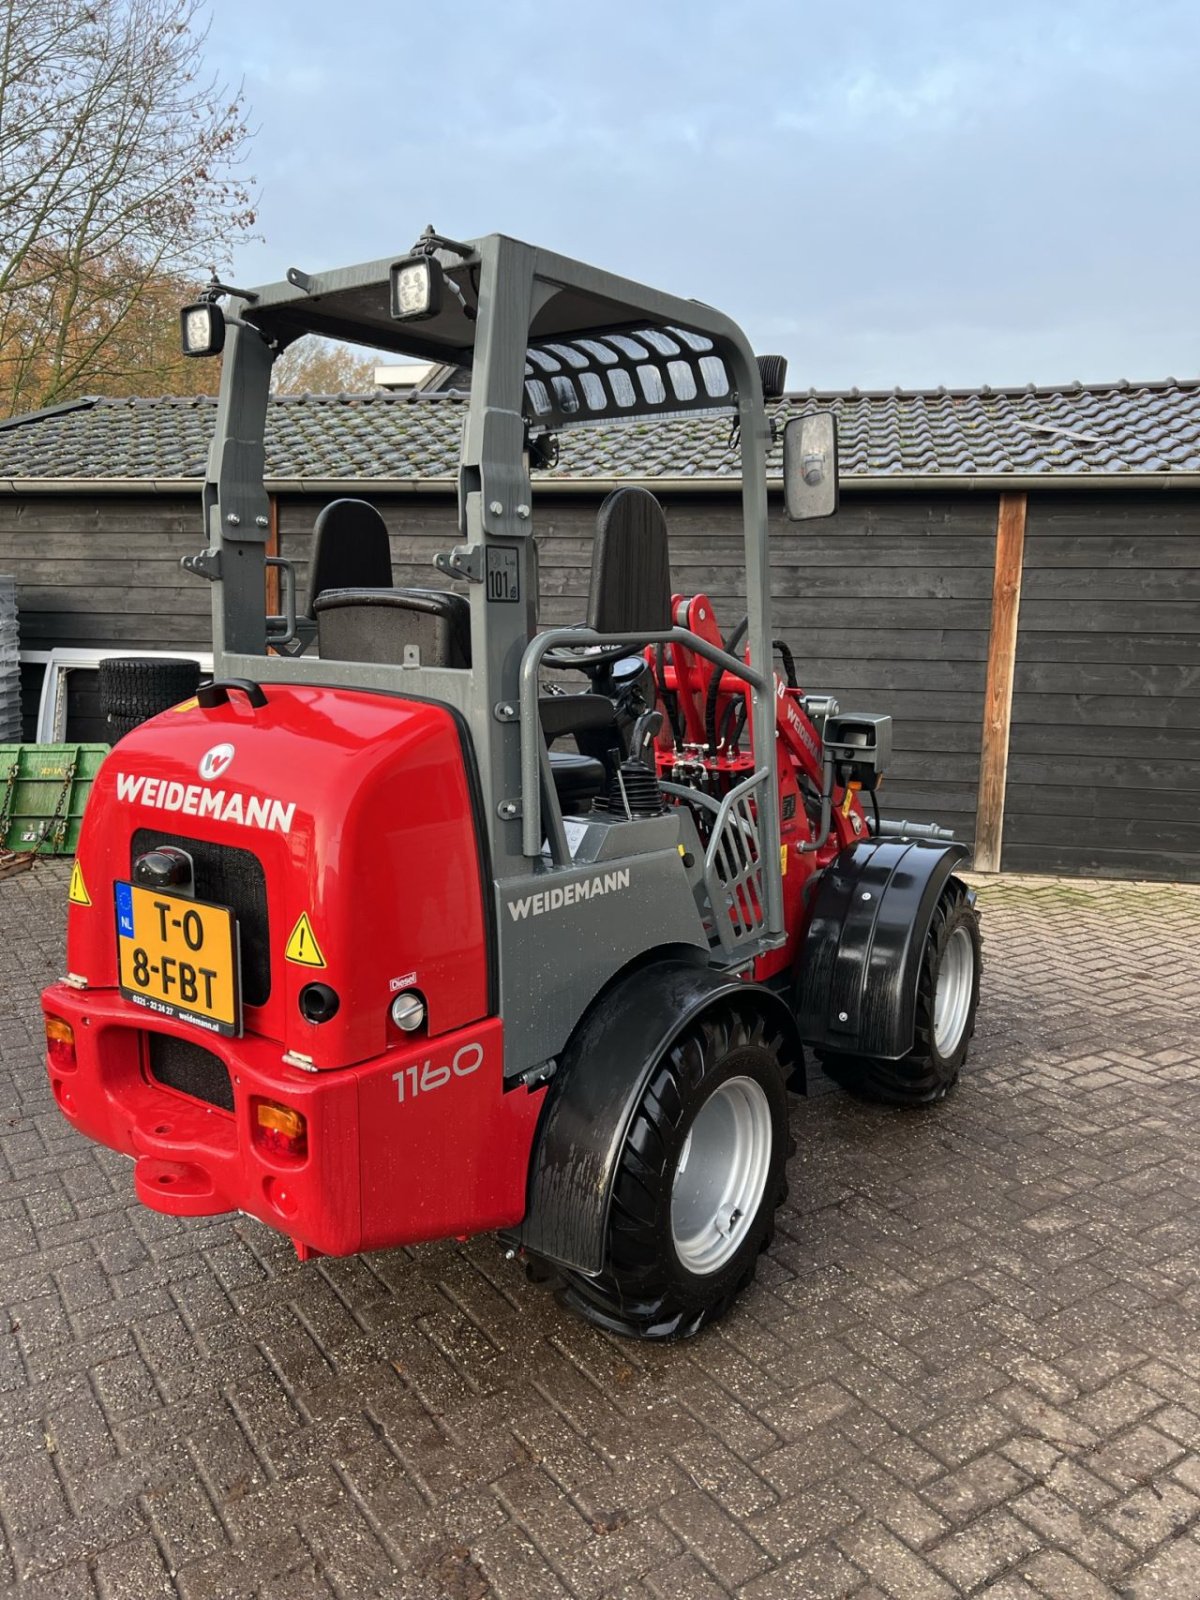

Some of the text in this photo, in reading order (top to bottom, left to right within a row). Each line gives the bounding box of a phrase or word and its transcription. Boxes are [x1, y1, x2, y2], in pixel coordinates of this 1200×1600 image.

[490, 570, 508, 598] 101
[116, 772, 297, 833] WEIDEMANN
[507, 868, 630, 922] WEIDEMANN
[121, 916, 132, 930] NL
[133, 947, 217, 1009] 8-FBT
[391, 974, 415, 990] Diesel
[178, 1012, 219, 1033] weidemann.nl
[392, 1042, 484, 1103] 1160
